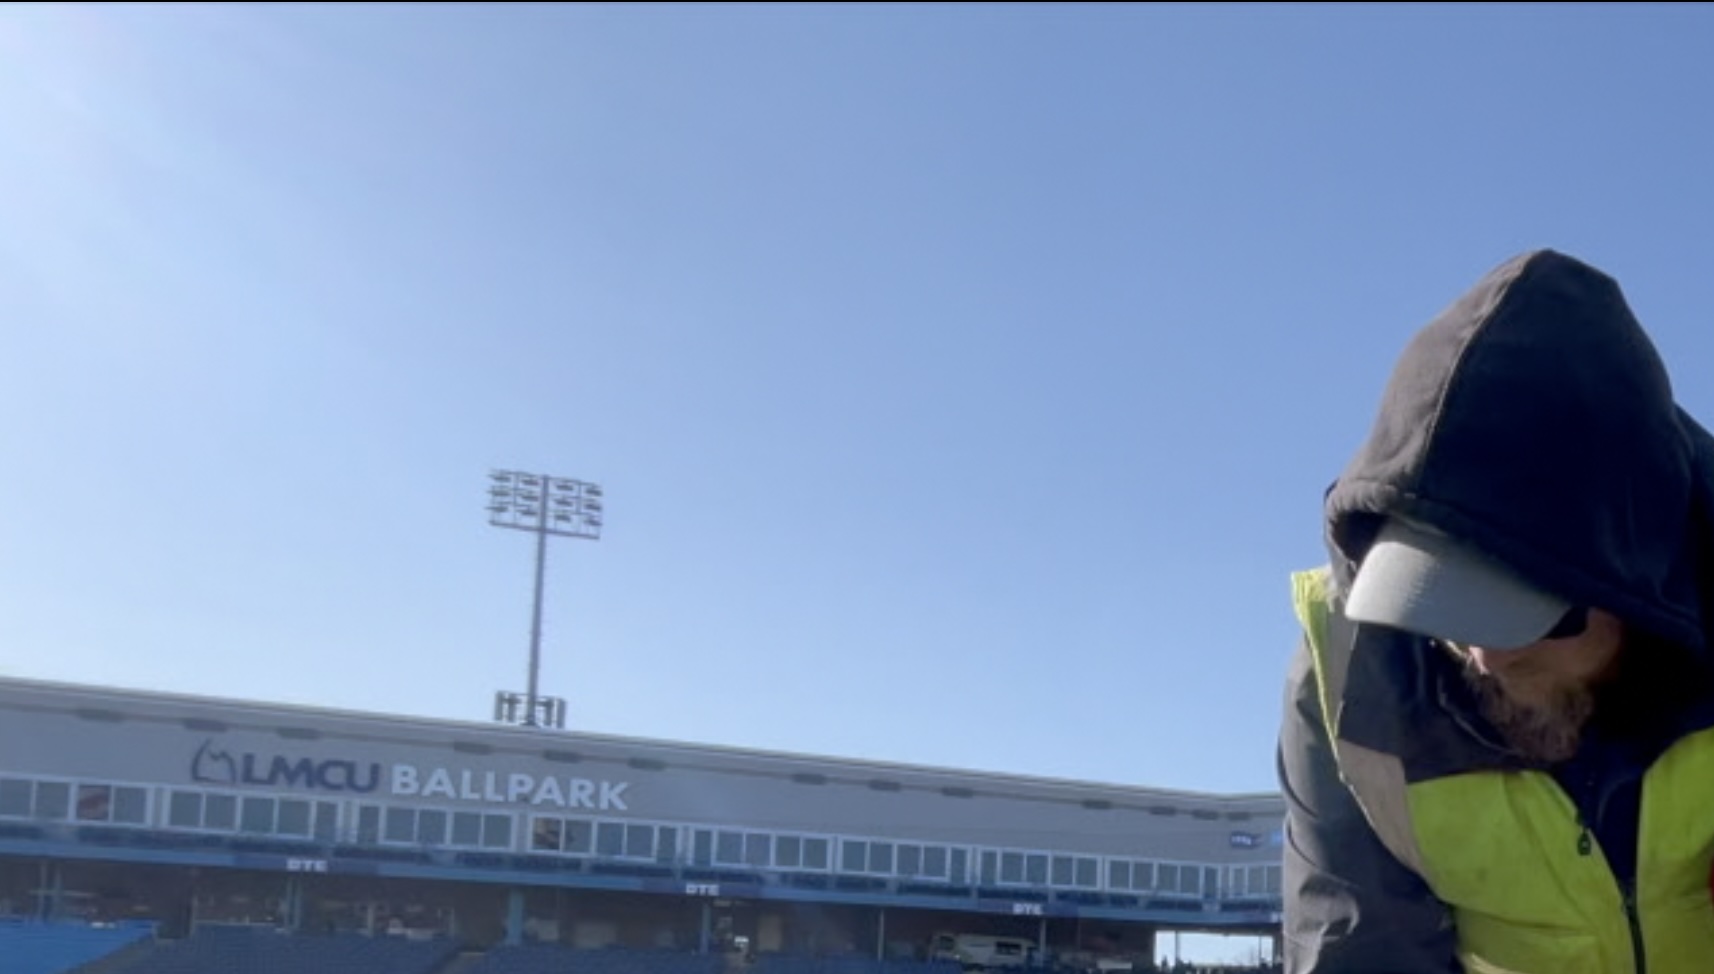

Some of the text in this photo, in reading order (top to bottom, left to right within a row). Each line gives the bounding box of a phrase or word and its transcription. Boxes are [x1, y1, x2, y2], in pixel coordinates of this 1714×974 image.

[241, 752, 629, 811] LMCU BALLPARK
[286, 857, 328, 872] DTE
[685, 881, 720, 897] DTE
